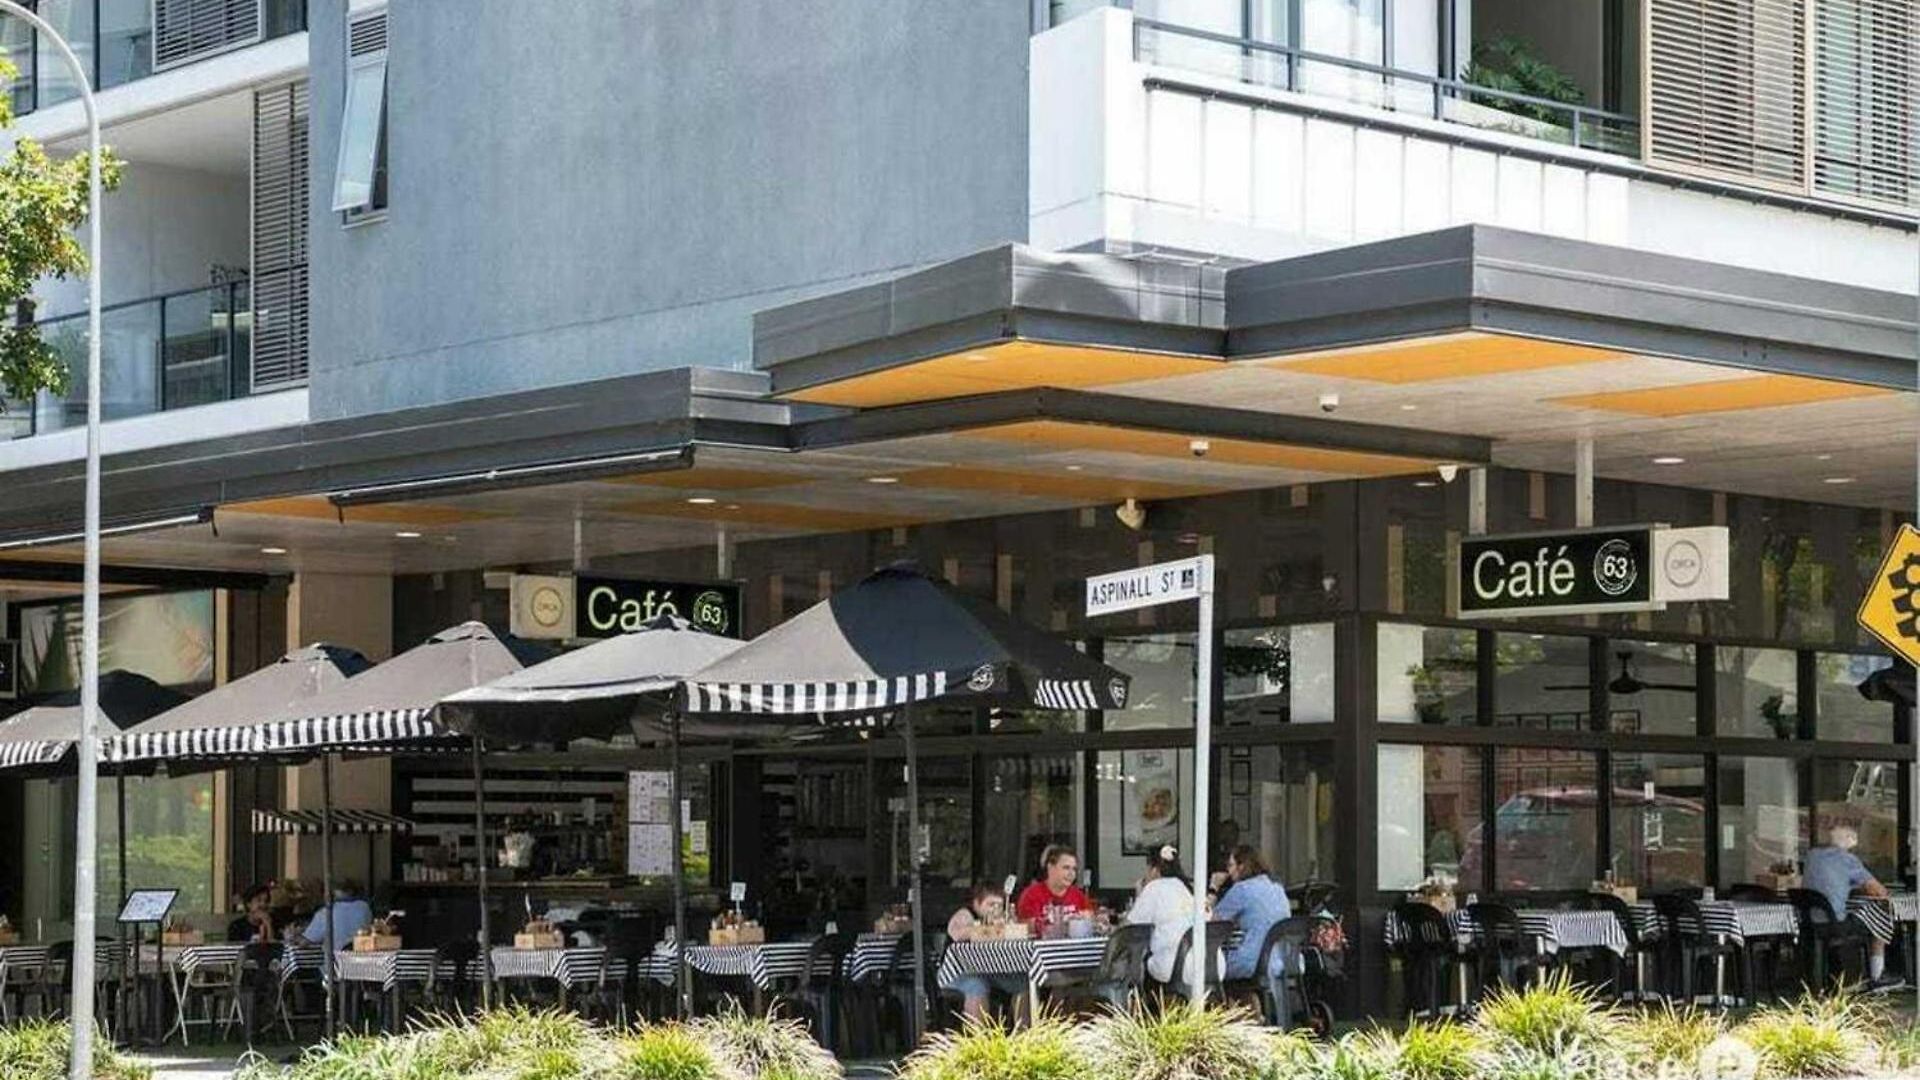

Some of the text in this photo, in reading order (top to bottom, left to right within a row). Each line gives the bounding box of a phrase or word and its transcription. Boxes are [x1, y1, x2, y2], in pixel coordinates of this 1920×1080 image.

[1473, 545, 1575, 600] Café
[1604, 555, 1628, 578] 63
[1091, 575, 1152, 606] ASPINALL
[1161, 570, 1175, 593] ST
[702, 603, 721, 625] 63
